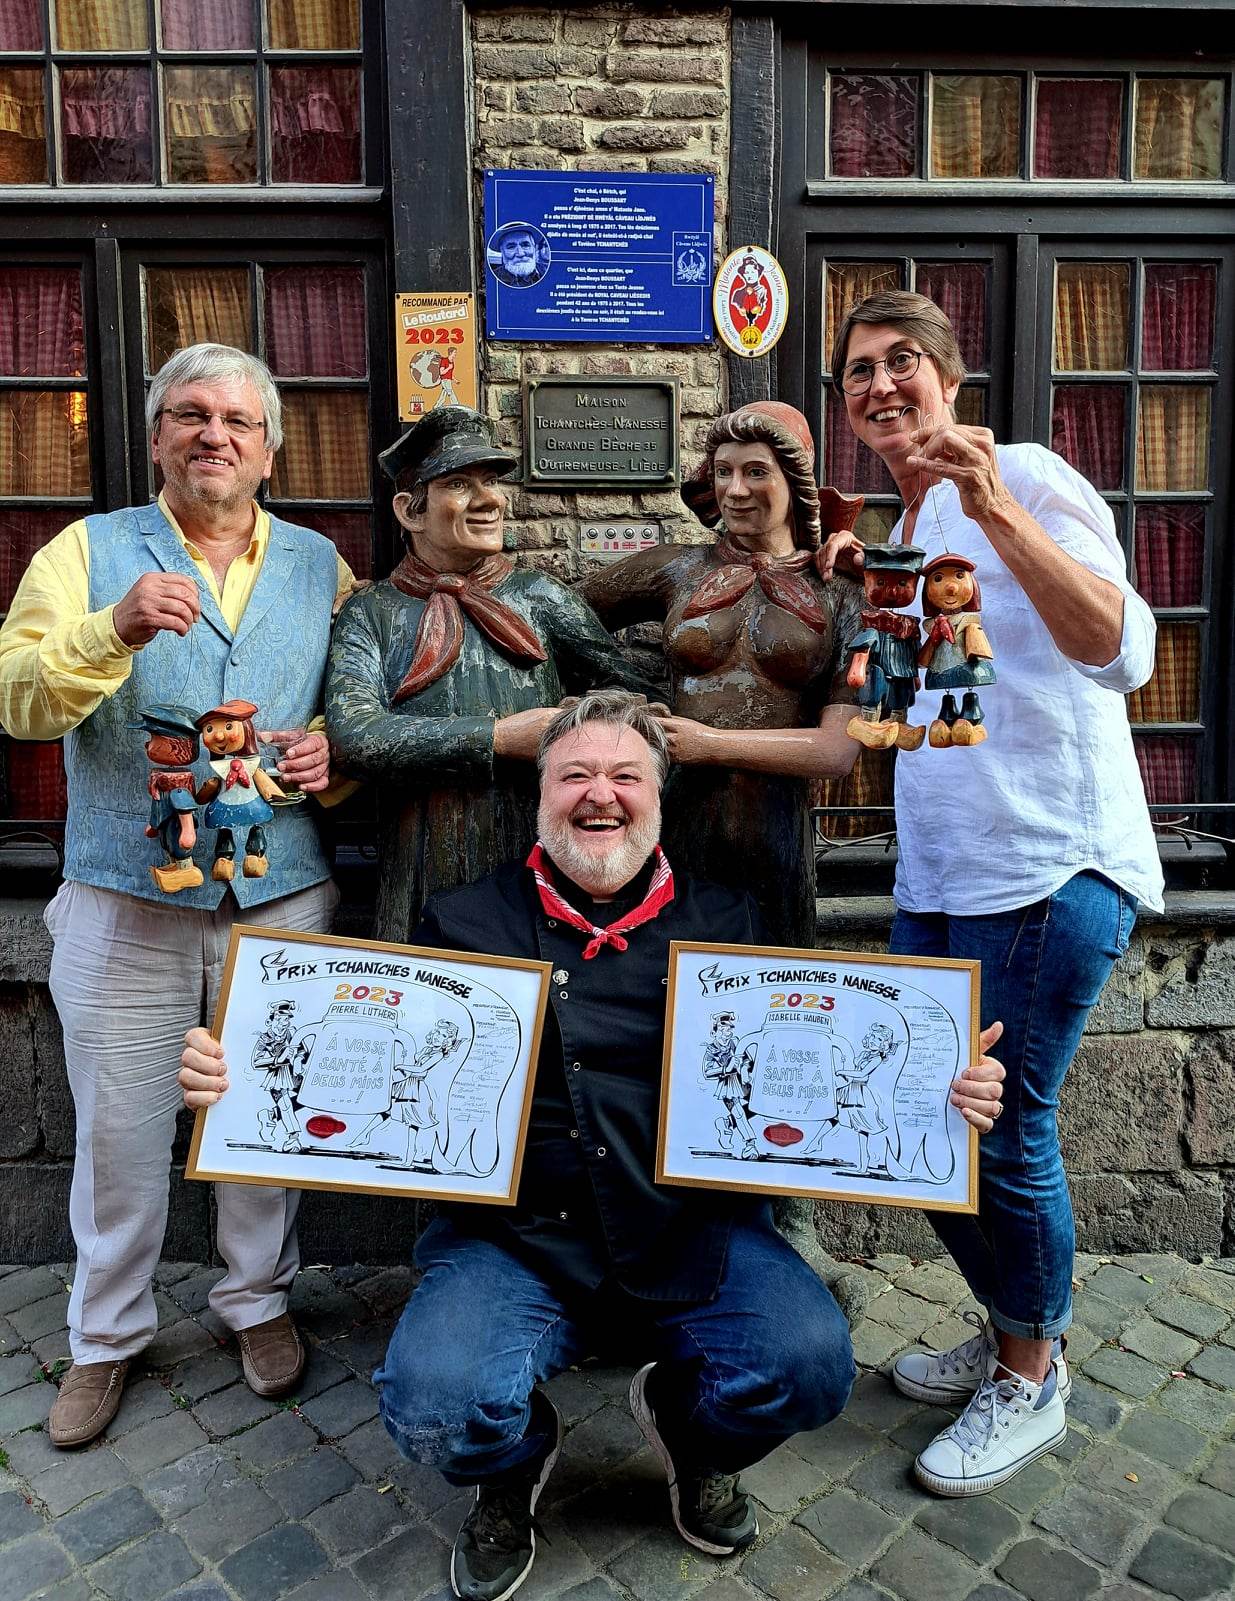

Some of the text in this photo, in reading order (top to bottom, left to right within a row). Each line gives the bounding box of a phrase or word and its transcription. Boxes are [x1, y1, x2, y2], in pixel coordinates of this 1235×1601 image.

[402, 296, 452, 307] RECOMMANDÉ
[405, 328, 465, 344] 2023
[644, 442, 657, 450] 35
[326, 961, 410, 977] TCHANTCHES
[414, 970, 473, 999] NANESSE
[757, 970, 837, 984] TCHANTCHES
[842, 974, 901, 1001] NANESSE
[334, 983, 404, 1006] 2023
[770, 993, 836, 1011] 2023
[331, 1005, 396, 1020] PIERRE LUTHERS
[768, 1012, 830, 1026] ISABELLE HAUBEN
[345, 1038, 388, 1056] VOSSE
[318, 1056, 368, 1073] SANTÉ
[782, 1049, 820, 1064] VOSSE
[764, 1064, 804, 1082] SANTÉ
